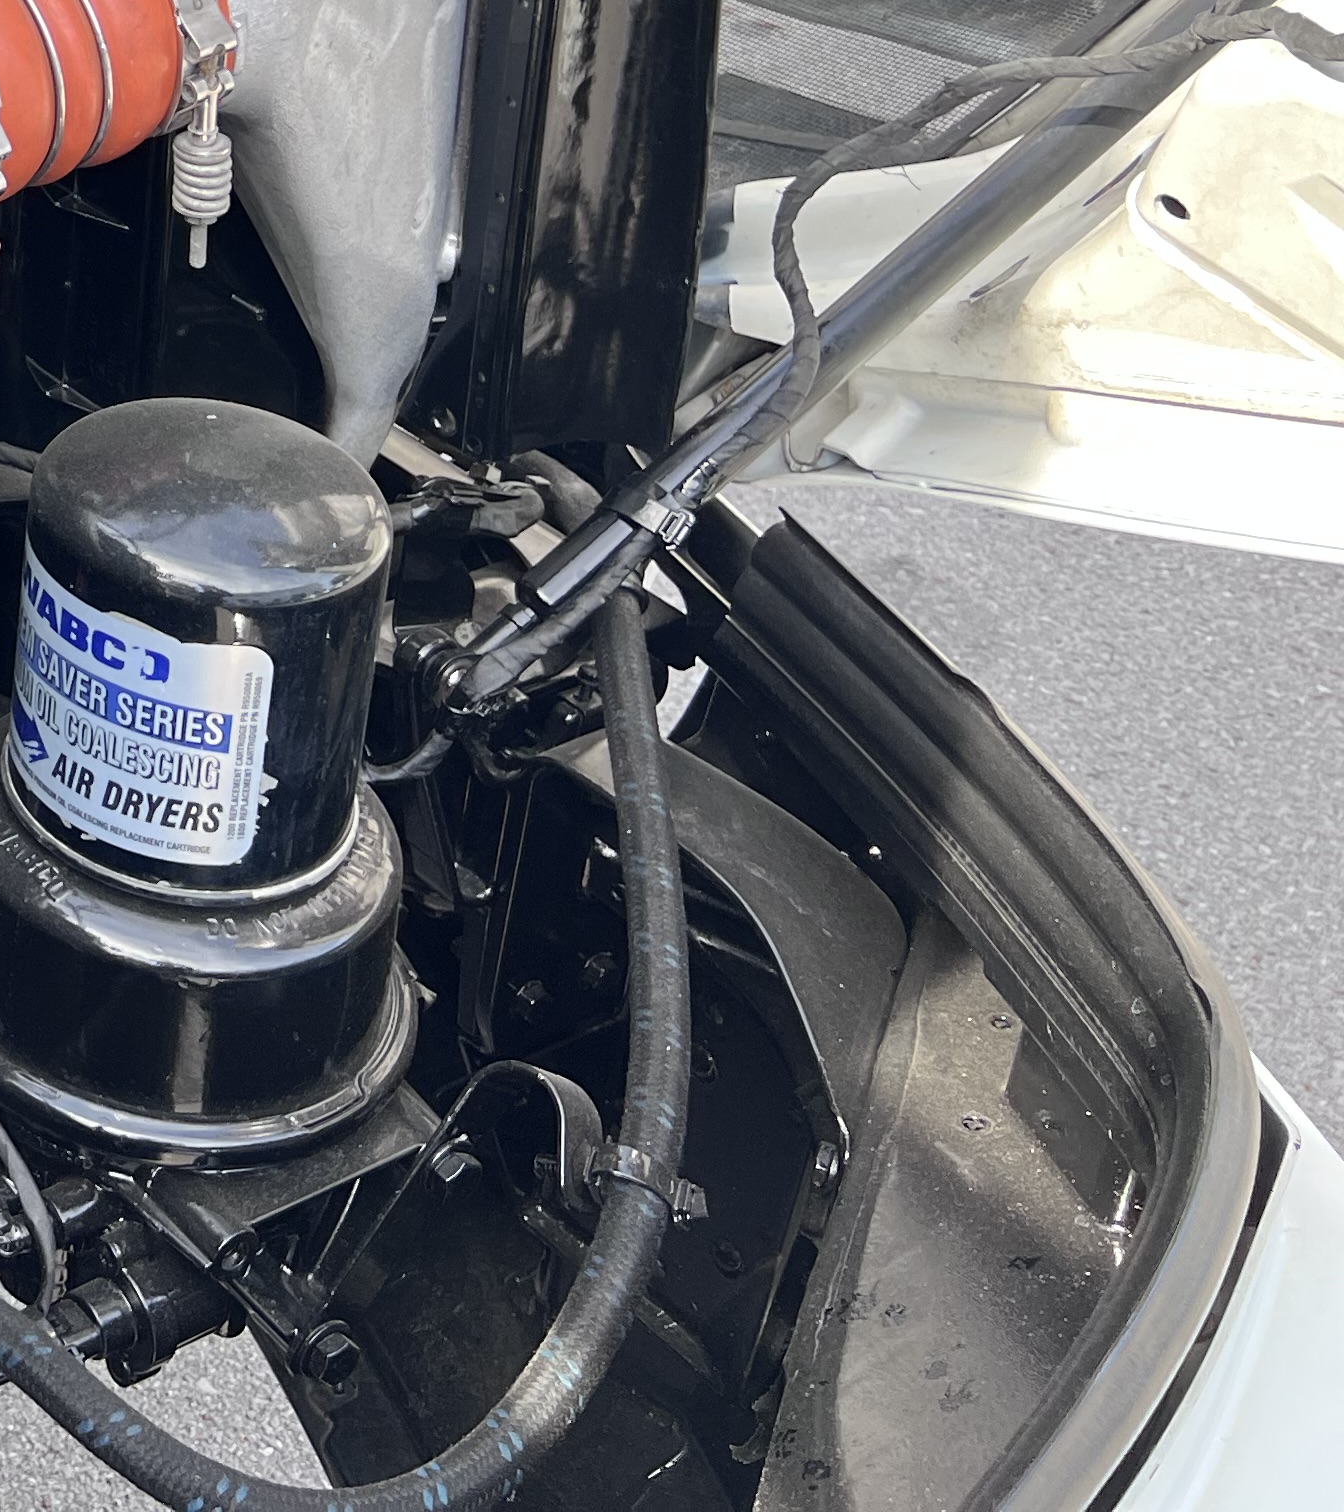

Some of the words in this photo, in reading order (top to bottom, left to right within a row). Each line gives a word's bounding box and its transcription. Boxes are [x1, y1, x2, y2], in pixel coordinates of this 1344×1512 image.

[37, 640, 108, 718] SAVER
[115, 691, 225, 746] SERIES
[34, 687, 60, 736] OIL
[64, 708, 221, 790] COALESCING
[235, 724, 248, 767] CARTRIDGE
[245, 724, 258, 766] CARTRIDGE
[51, 752, 96, 800] AIR
[101, 779, 224, 833] DRYERS
[229, 768, 243, 822] REPLACEMENT
[238, 768, 253, 822] REPLACEMENT
[109, 825, 165, 848] REPLACEMENT
[166, 841, 211, 855] CARTRIDGE
